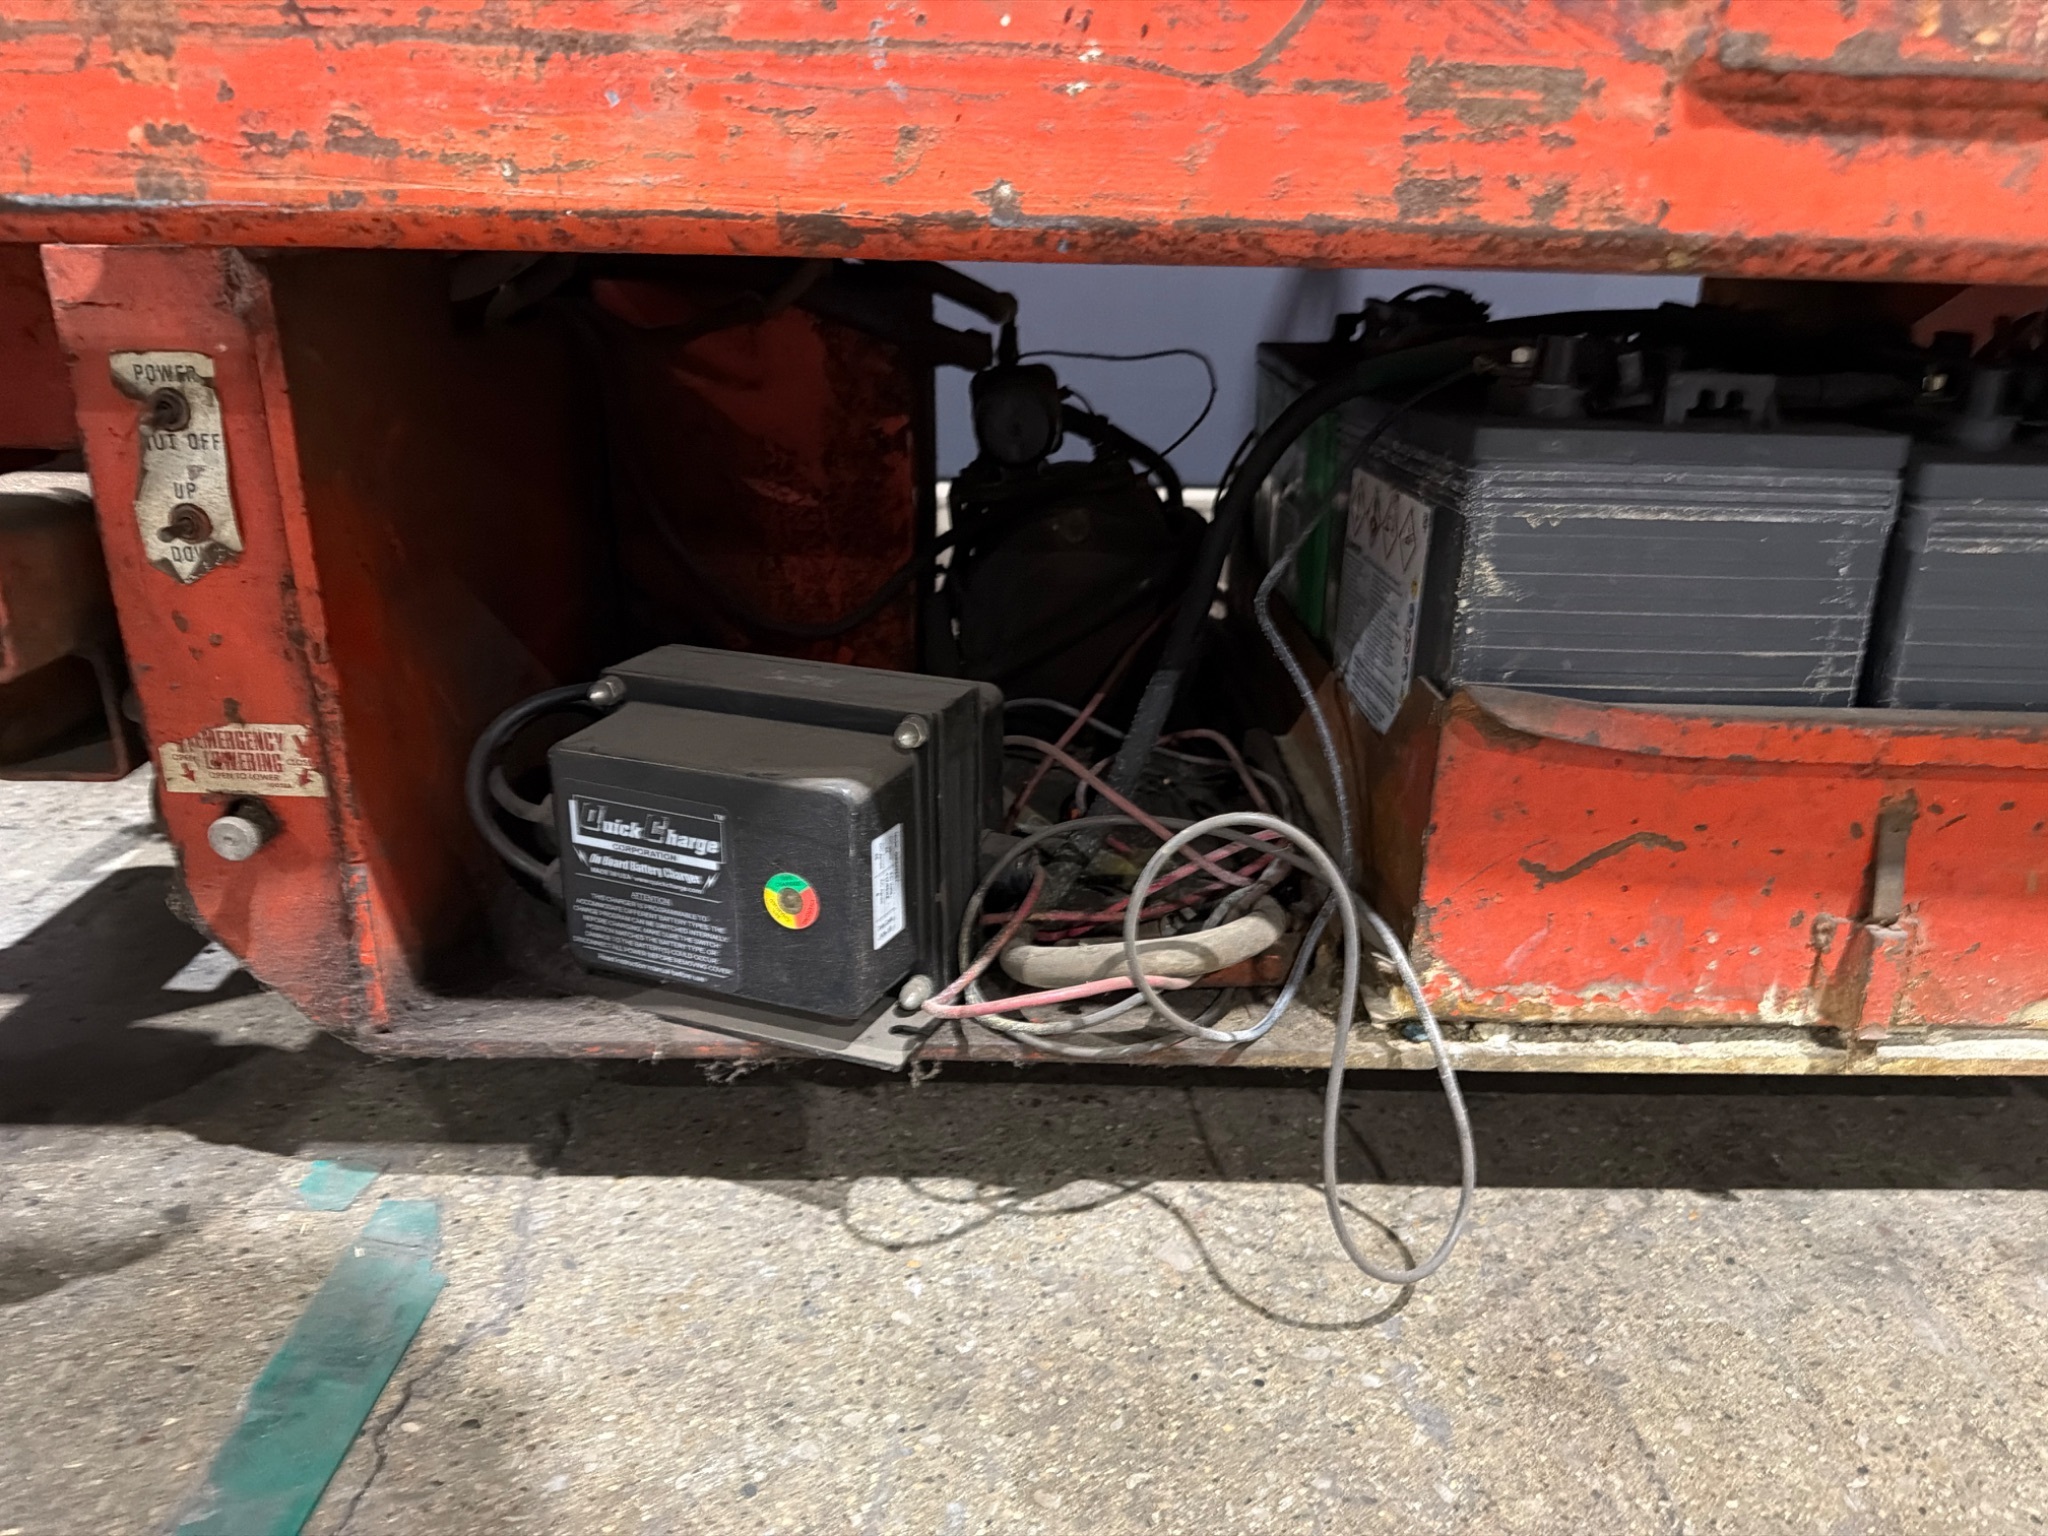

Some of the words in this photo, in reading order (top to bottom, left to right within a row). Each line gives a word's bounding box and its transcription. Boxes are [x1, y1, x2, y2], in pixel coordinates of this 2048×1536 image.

[132, 363, 196, 383] POWER
[147, 433, 177, 451] UT
[187, 433, 220, 451] OFF
[174, 482, 196, 499] UP
[171, 545, 199, 563] DO
[208, 771, 233, 779] OPEN
[236, 772, 247, 780] TO
[248, 773, 280, 781] LOWER
[580, 802, 644, 839] Quick
[644, 814, 720, 856] Charge
[612, 843, 677, 861] CORPORATION
[601, 855, 628, 870] Board
[629, 860, 663, 878] Battery
[663, 867, 703, 885] Charger
